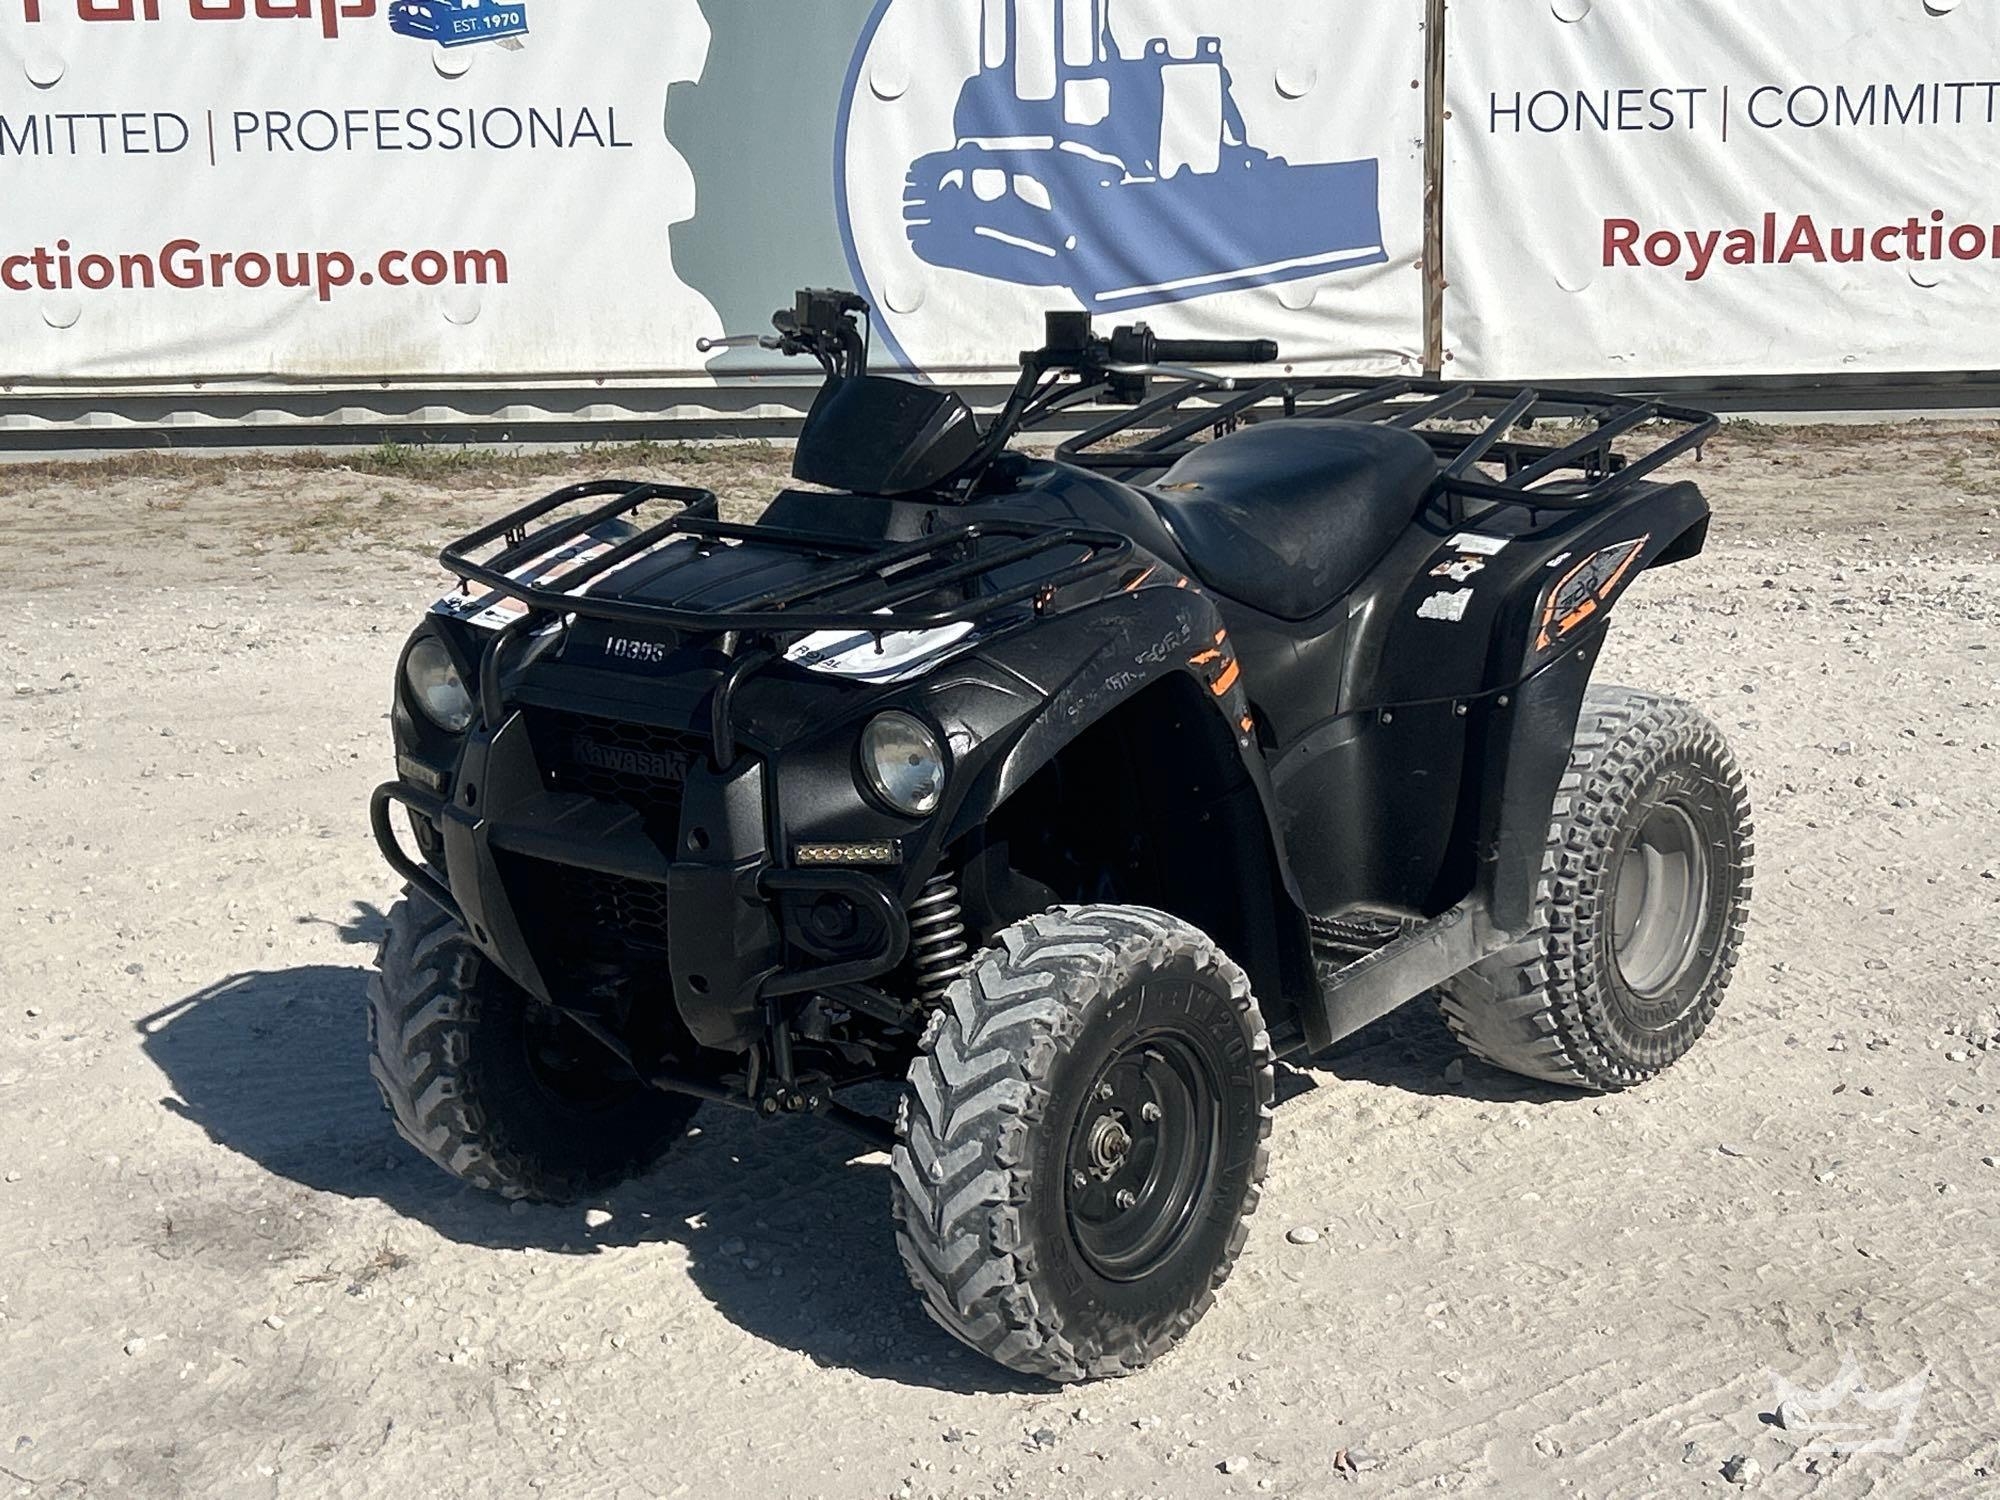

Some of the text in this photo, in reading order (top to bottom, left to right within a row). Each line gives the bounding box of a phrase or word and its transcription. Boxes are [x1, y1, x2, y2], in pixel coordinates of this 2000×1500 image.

[453, 12, 519, 33] EST. 1970
[0, 106, 633, 156] MITTED PROFESSIONAL
[1490, 81, 2000, 133] HONEST COMMITT
[1, 239, 508, 300] ctionGroup.com
[1602, 210, 2000, 281] RoyalAuctio
[573, 736, 688, 781] Kawasaki
